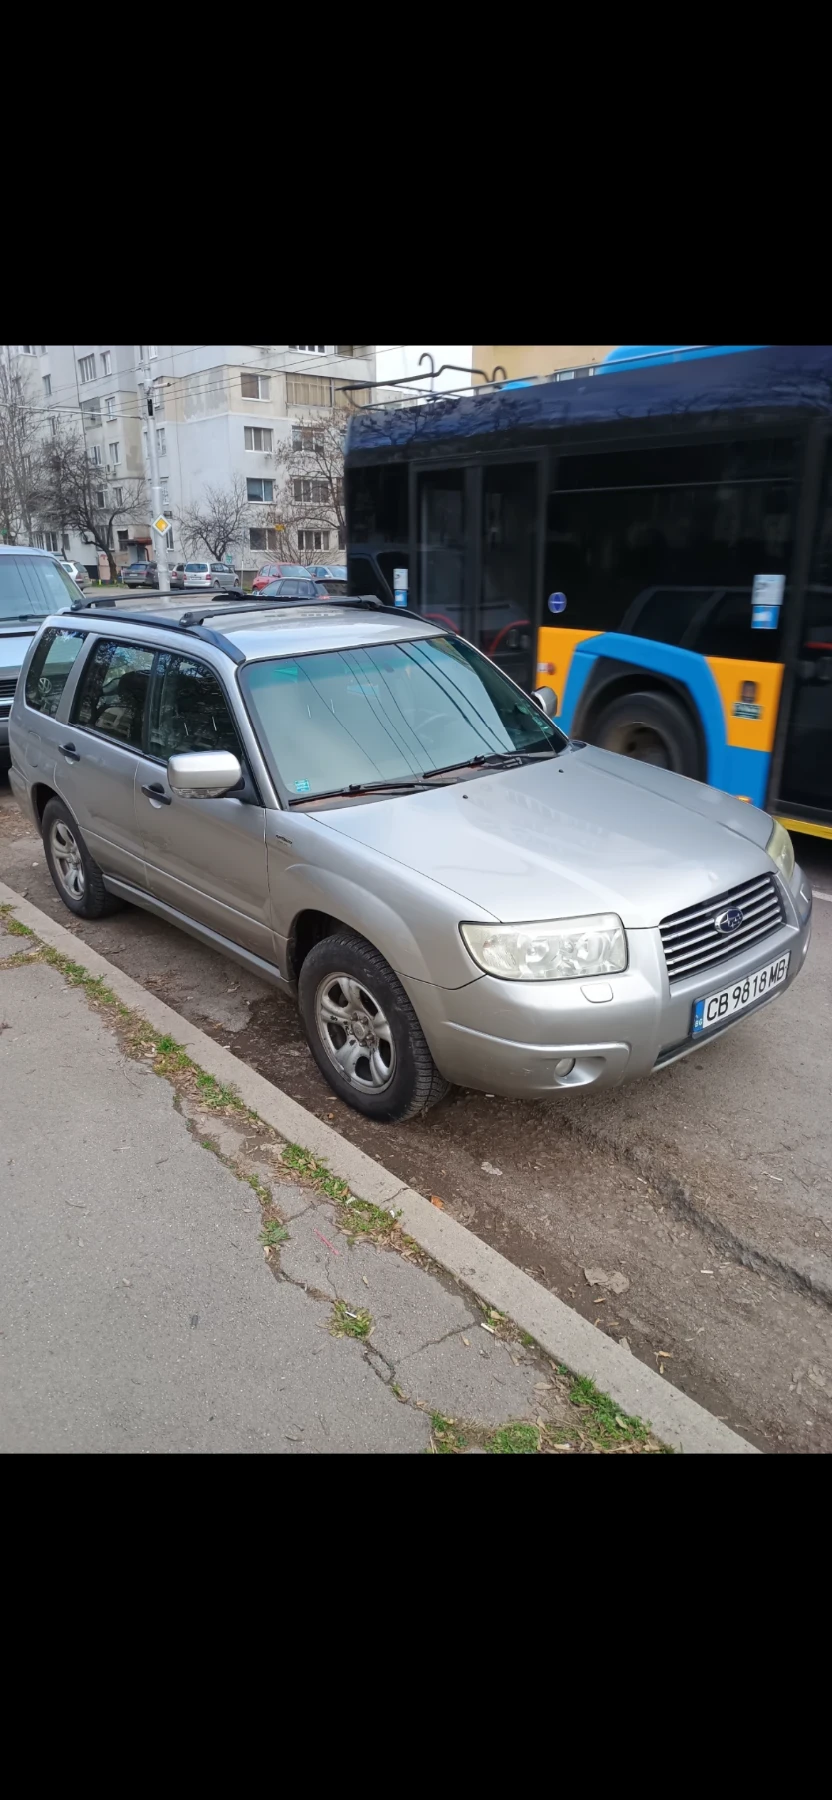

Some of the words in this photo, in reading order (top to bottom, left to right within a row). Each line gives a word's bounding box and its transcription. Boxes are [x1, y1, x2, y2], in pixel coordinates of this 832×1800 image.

[706, 992, 729, 1021] CB
[732, 970, 767, 1009] 9818
[768, 958, 786, 987] MB
[694, 1018, 703, 1028] BG
